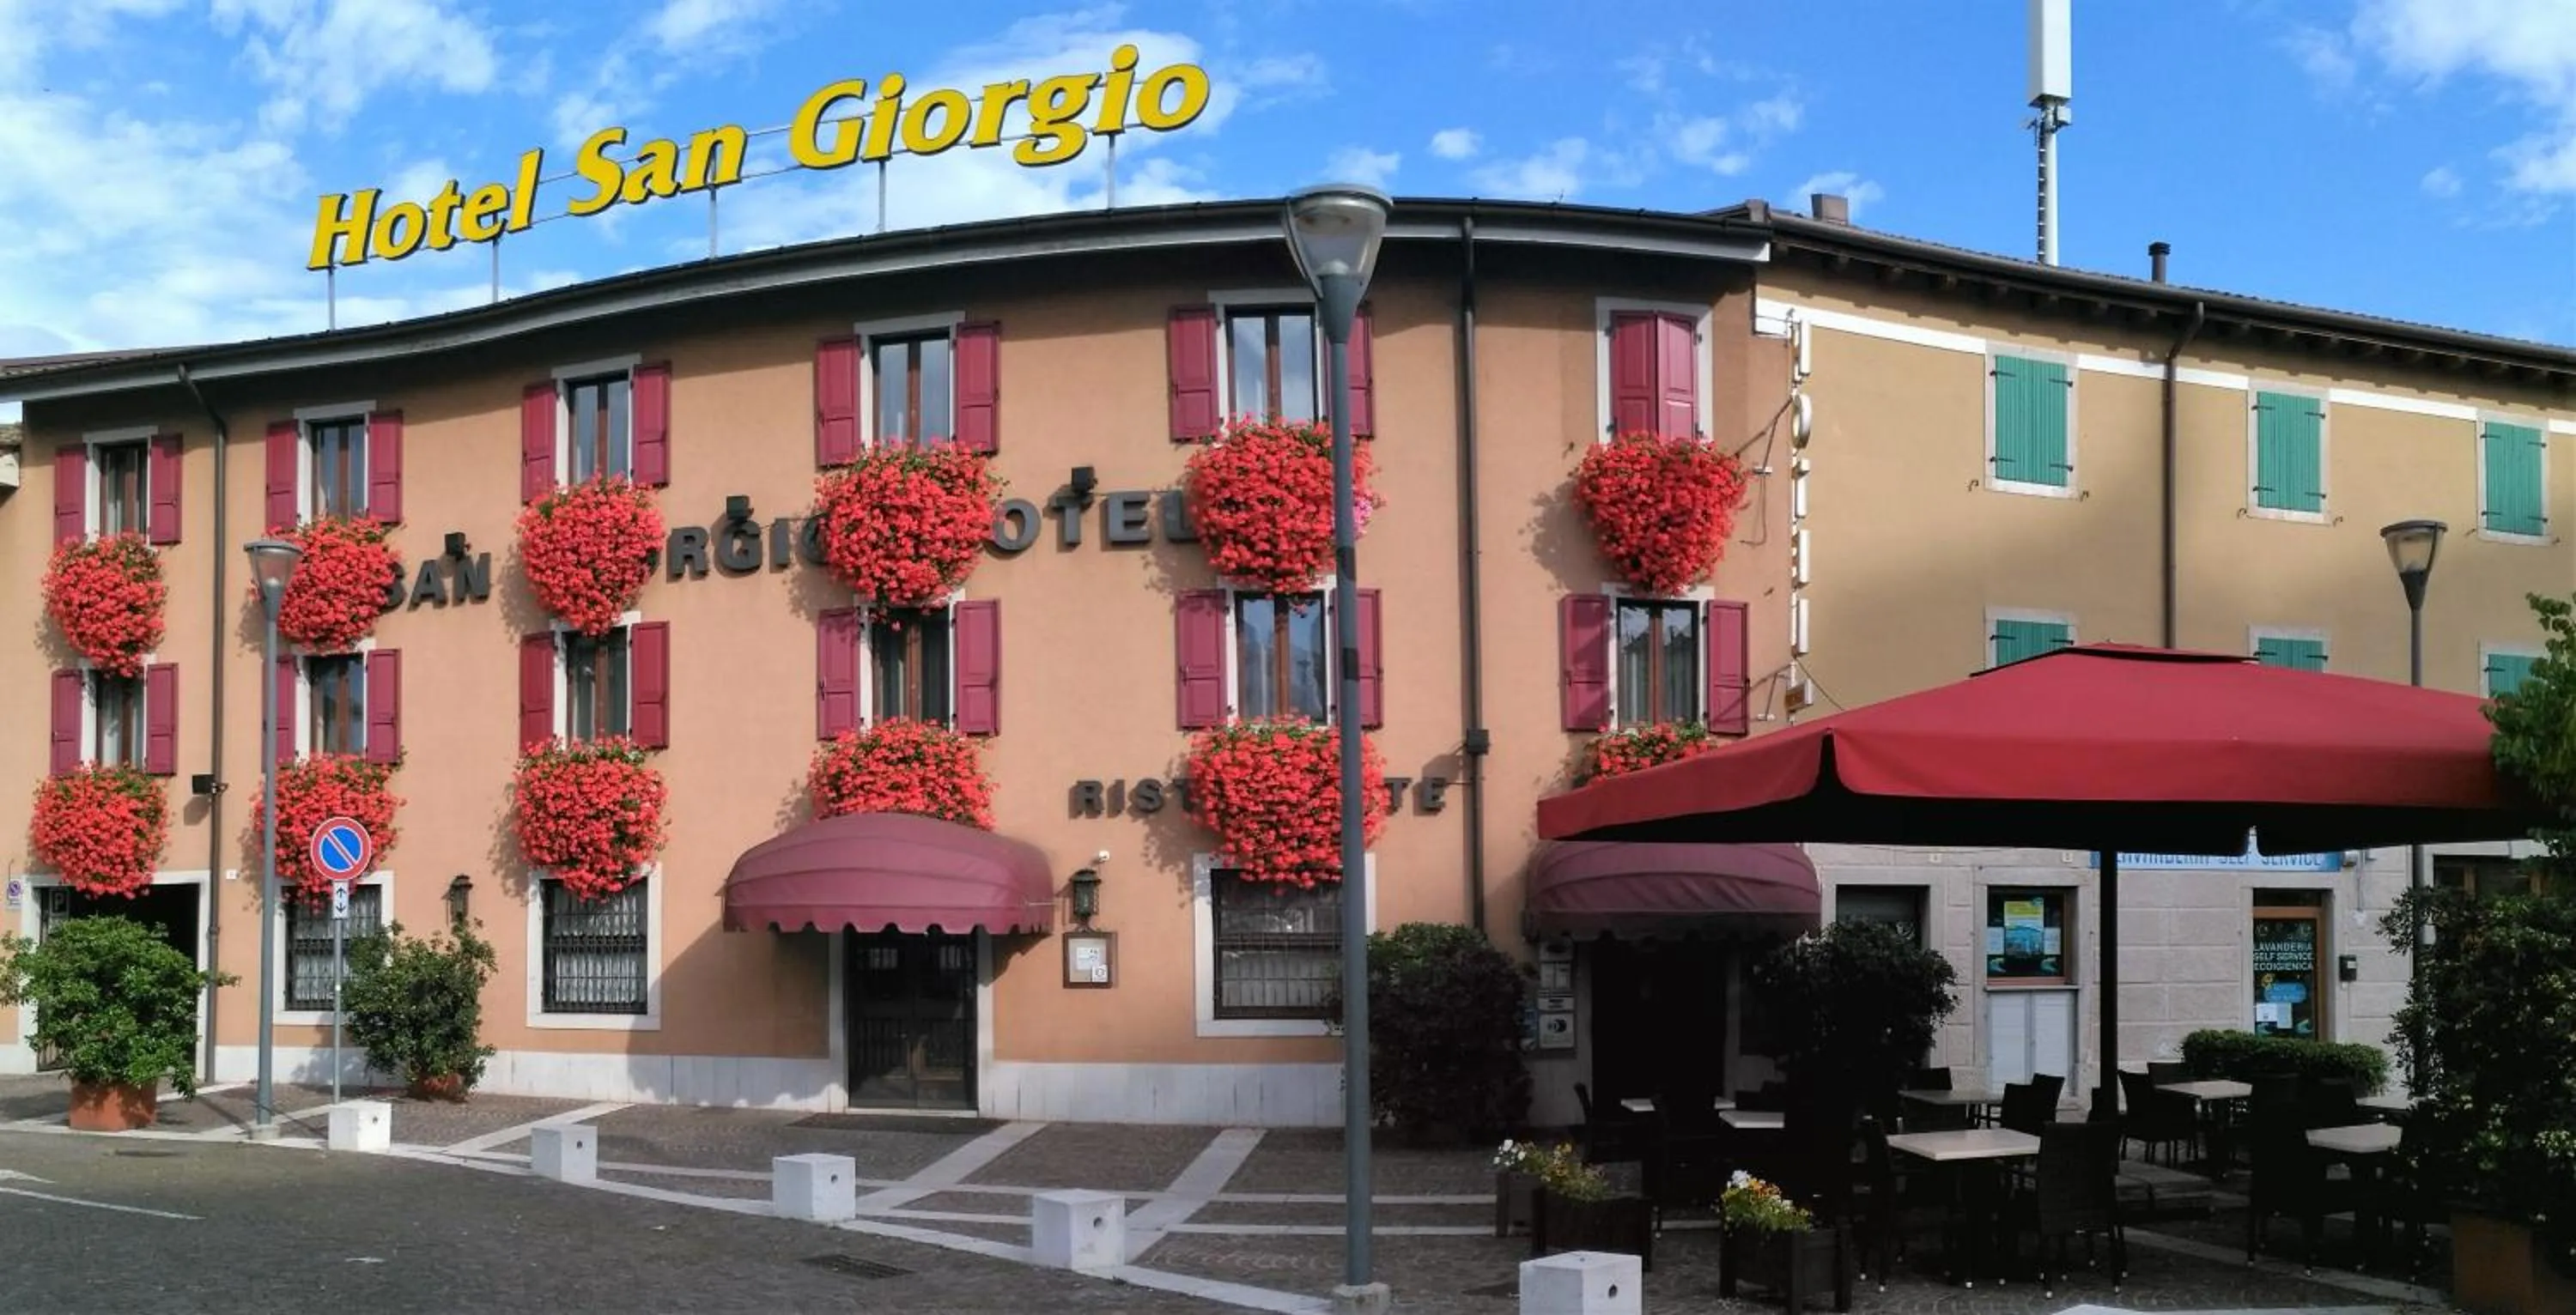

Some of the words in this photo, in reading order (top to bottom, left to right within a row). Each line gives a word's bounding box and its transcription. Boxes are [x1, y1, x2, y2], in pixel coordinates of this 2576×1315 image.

[307, 148, 543, 270] Hotel
[567, 124, 749, 216] San
[788, 44, 1210, 168] Giorgio
[993, 489, 1199, 550] OTEL
[2253, 952, 2276, 960] SELF
[2254, 942, 2313, 951] LAVANDERIA
